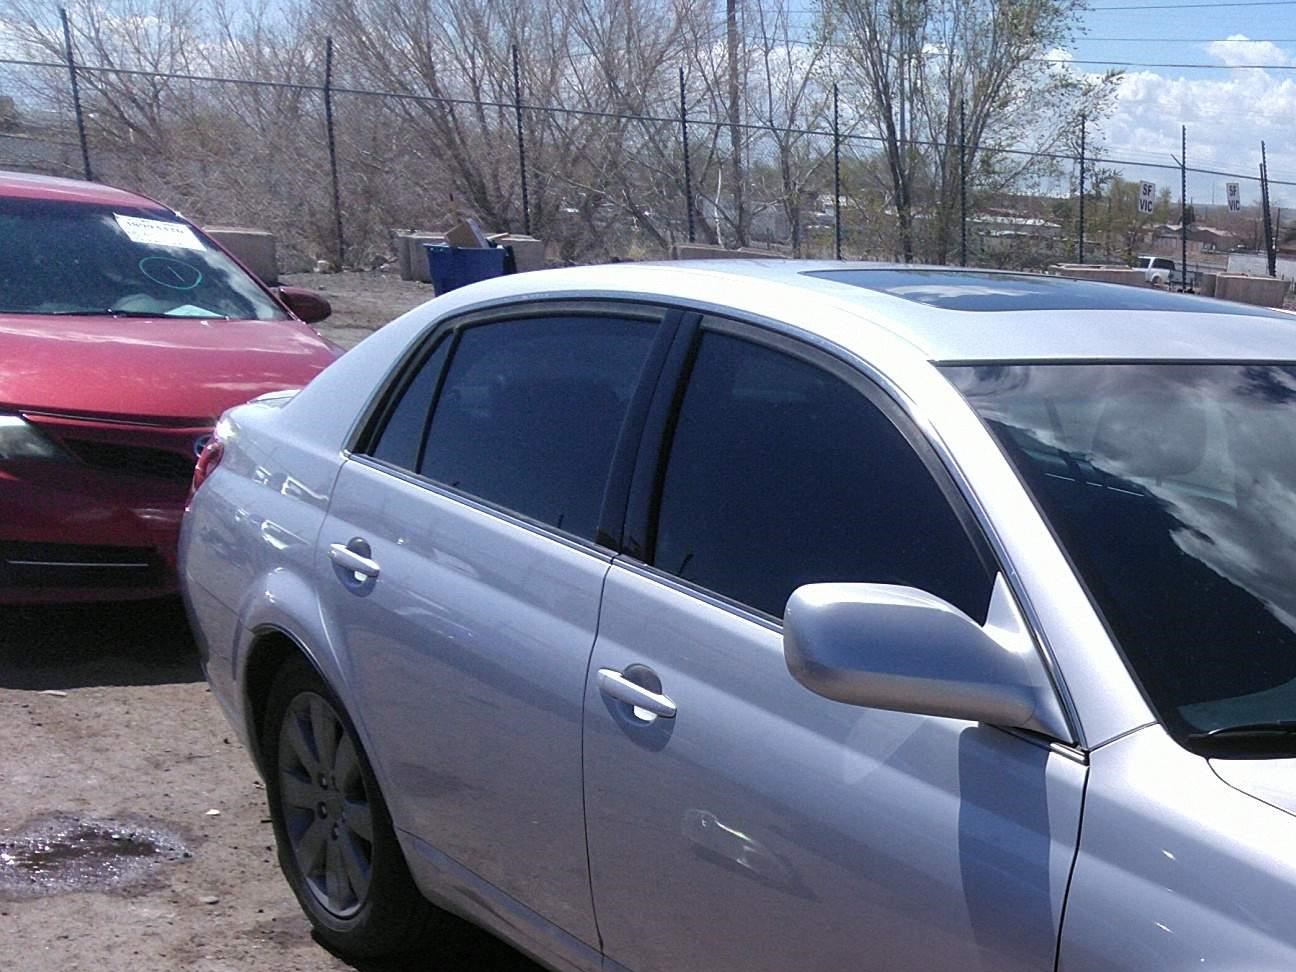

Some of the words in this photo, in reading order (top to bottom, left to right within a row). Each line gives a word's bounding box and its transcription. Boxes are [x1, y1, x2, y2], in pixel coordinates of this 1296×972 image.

[1142, 183, 1153, 197] SF
[1229, 184, 1237, 197] SF
[1139, 199, 1153, 212] VIC
[1228, 199, 1241, 211] VIC
